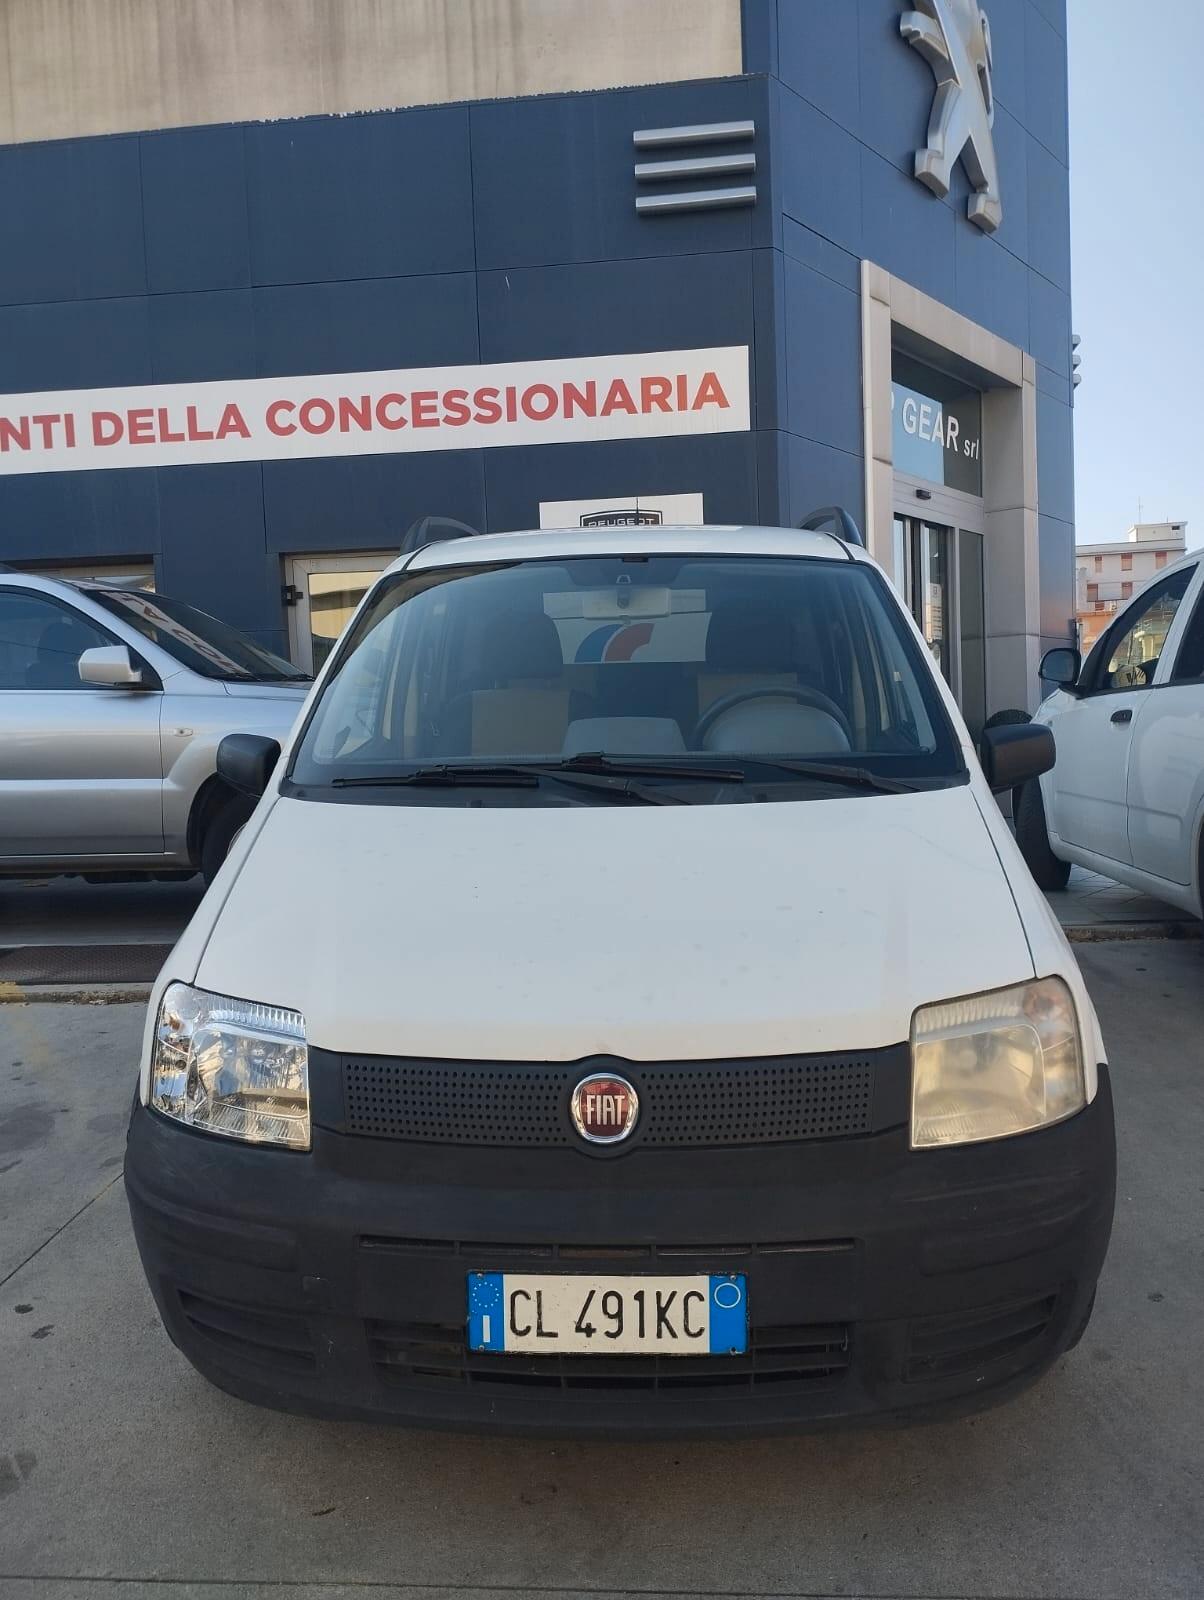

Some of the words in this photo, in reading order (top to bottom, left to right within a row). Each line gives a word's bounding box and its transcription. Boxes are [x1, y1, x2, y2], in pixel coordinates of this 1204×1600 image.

[92, 404, 250, 445] DELLA
[266, 372, 728, 436] CONCESSIONARIA
[902, 398, 959, 452] GEAR
[964, 438, 979, 460] srl
[586, 1094, 626, 1126] FIAT
[510, 1290, 558, 1337] CL
[575, 1290, 704, 1338] 491KC
